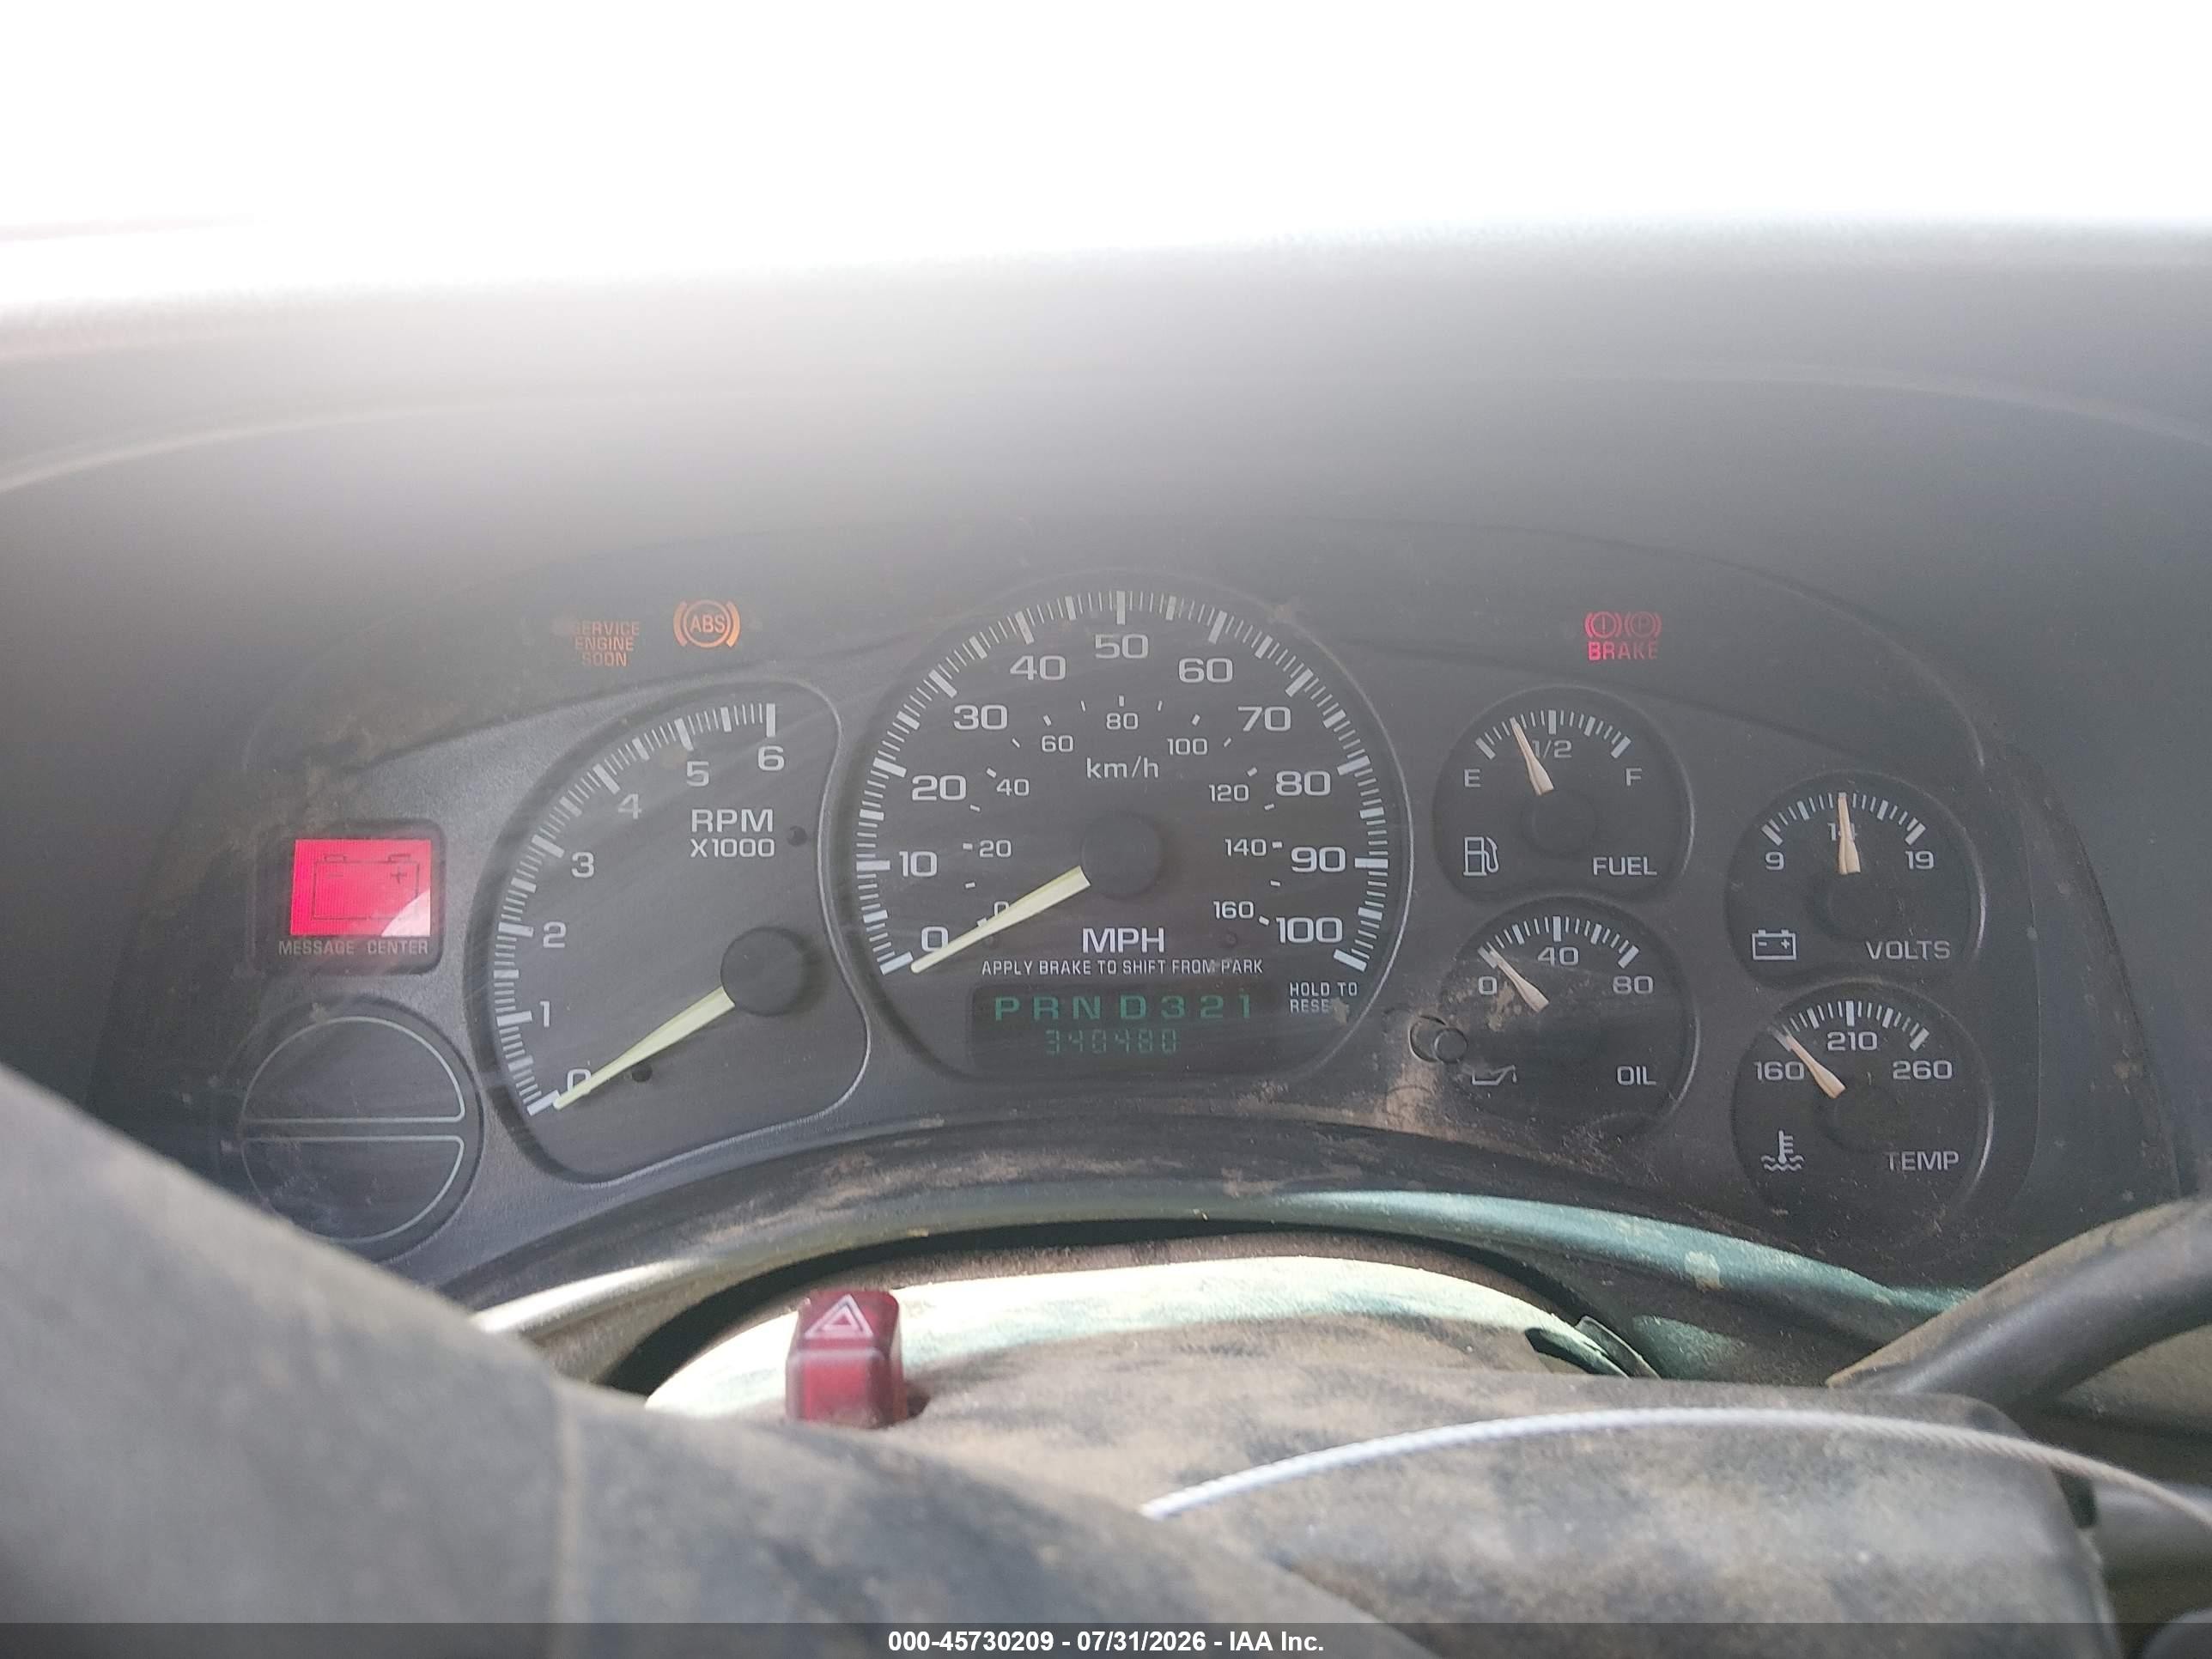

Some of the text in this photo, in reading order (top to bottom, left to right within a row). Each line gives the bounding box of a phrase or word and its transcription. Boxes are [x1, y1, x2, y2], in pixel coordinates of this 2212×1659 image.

[690, 615, 726, 633] ABS
[574, 636, 634, 651] ENGINE
[1095, 634, 1149, 659] 50
[1588, 641, 1658, 660] BRAKE
[582, 652, 628, 666] SOON
[1009, 655, 1066, 681] 40
[1178, 658, 1233, 684] 60
[953, 704, 1008, 731] 30
[1105, 713, 1139, 730] 80
[1237, 706, 1291, 732] 70
[1041, 735, 1074, 753] 60
[1166, 738, 1208, 756] 100
[1534, 739, 1573, 759] 1/2
[757, 744, 786, 772] 6
[1085, 756, 1159, 779] km/h
[686, 761, 710, 787] 5
[1275, 770, 1331, 797] 80
[1463, 769, 1481, 787] E
[1626, 768, 1643, 787] F
[911, 775, 967, 801] 20
[996, 778, 1030, 797] 40
[1208, 783, 1249, 802] 120
[617, 793, 643, 820] 4
[690, 809, 775, 833] RPM
[1826, 822, 1856, 842] 1
[690, 838, 775, 859] X1000
[979, 840, 1012, 858] 20
[1224, 838, 1267, 857] 140
[570, 851, 596, 878] 3
[899, 850, 939, 878] 10
[1290, 846, 1346, 873] 90
[1592, 856, 1658, 876] FUEL
[1764, 851, 1786, 871] 9
[1905, 850, 1936, 870] 19
[1212, 900, 1255, 919] 160
[542, 921, 568, 949] 2
[921, 926, 950, 952] 0
[1275, 916, 1344, 944] 100
[277, 940, 429, 956] MESSAGE CENTER
[1082, 927, 1165, 954] MPH
[1865, 940, 1951, 961] VOLTS
[1537, 946, 1580, 966] 40
[981, 958, 1263, 975] APPLY BRAKE TO SHIFT FROM PARK
[1290, 981, 1358, 997] HOLD TO
[1478, 975, 1498, 995] 0
[1612, 975, 1654, 994] 80
[539, 1000, 550, 1027] 1
[1290, 998, 1334, 1013] RESE
[1826, 1031, 1878, 1051] 210
[1617, 1066, 1656, 1085] OIL
[1754, 1060, 1804, 1081] 160
[1892, 1060, 1953, 1080] 260
[1886, 1151, 1959, 1171] TEMP
